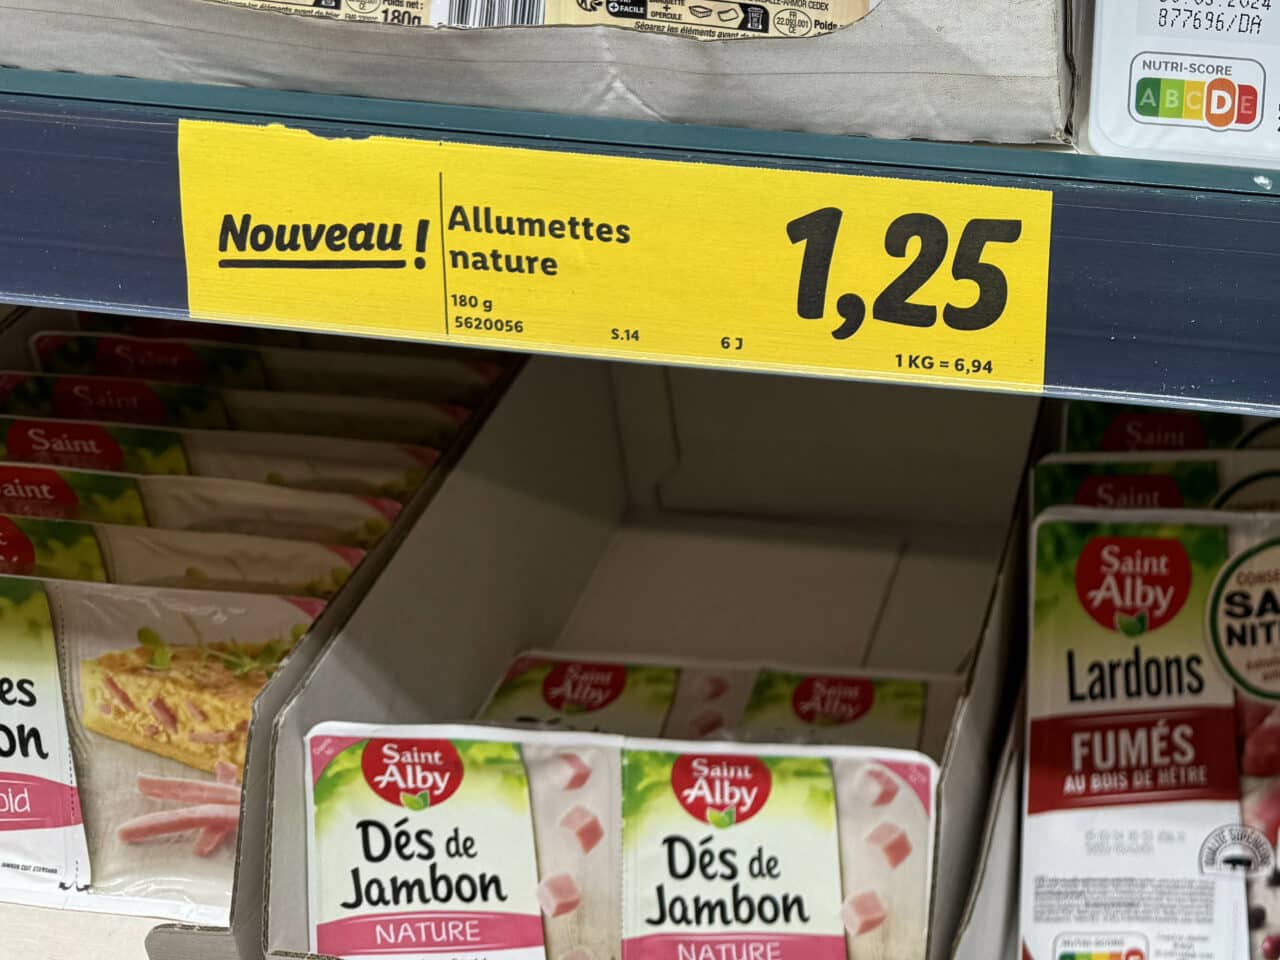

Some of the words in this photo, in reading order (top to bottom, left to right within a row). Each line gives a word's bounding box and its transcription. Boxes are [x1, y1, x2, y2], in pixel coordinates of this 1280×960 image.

[1158, 8, 1262, 35] 877696/DA
[1142, 59, 1232, 76] NUTRI-SCORE
[1210, 89, 1232, 116] D
[218, 213, 402, 252] Nouveau
[448, 205, 630, 243] Allumettes
[450, 248, 558, 276] nature
[786, 206, 1022, 340] 1,25
[451, 294, 478, 309] 180
[483, 297, 493, 312] g
[455, 316, 524, 333] 5620056
[611, 327, 640, 342] S.14
[720, 336, 730, 351] 6
[735, 337, 743, 351] J
[896, 353, 903, 368] 1
[908, 355, 934, 370] KG
[954, 357, 993, 374] 6,94
[27, 427, 103, 454] Saint
[1101, 545, 1169, 575] Saint
[1088, 573, 1175, 616] Alby
[1067, 645, 1205, 703] Lardons
[382, 744, 442, 765] Saint
[1071, 718, 1195, 771] FUMÉS
[374, 764, 450, 795] Alby
[692, 758, 752, 780] Saint
[1063, 775, 1085, 793] AU
[1090, 772, 1128, 792] BOIS
[1133, 769, 1154, 788] DE
[682, 777, 759, 811] Alby
[356, 817, 435, 863] Dés
[446, 827, 478, 858] de
[662, 835, 738, 881] Dés
[749, 848, 781, 879] de
[340, 862, 508, 909] Jambon
[645, 880, 810, 926] Jambon
[375, 920, 481, 944] NATURE
[677, 942, 782, 960] NATURE
